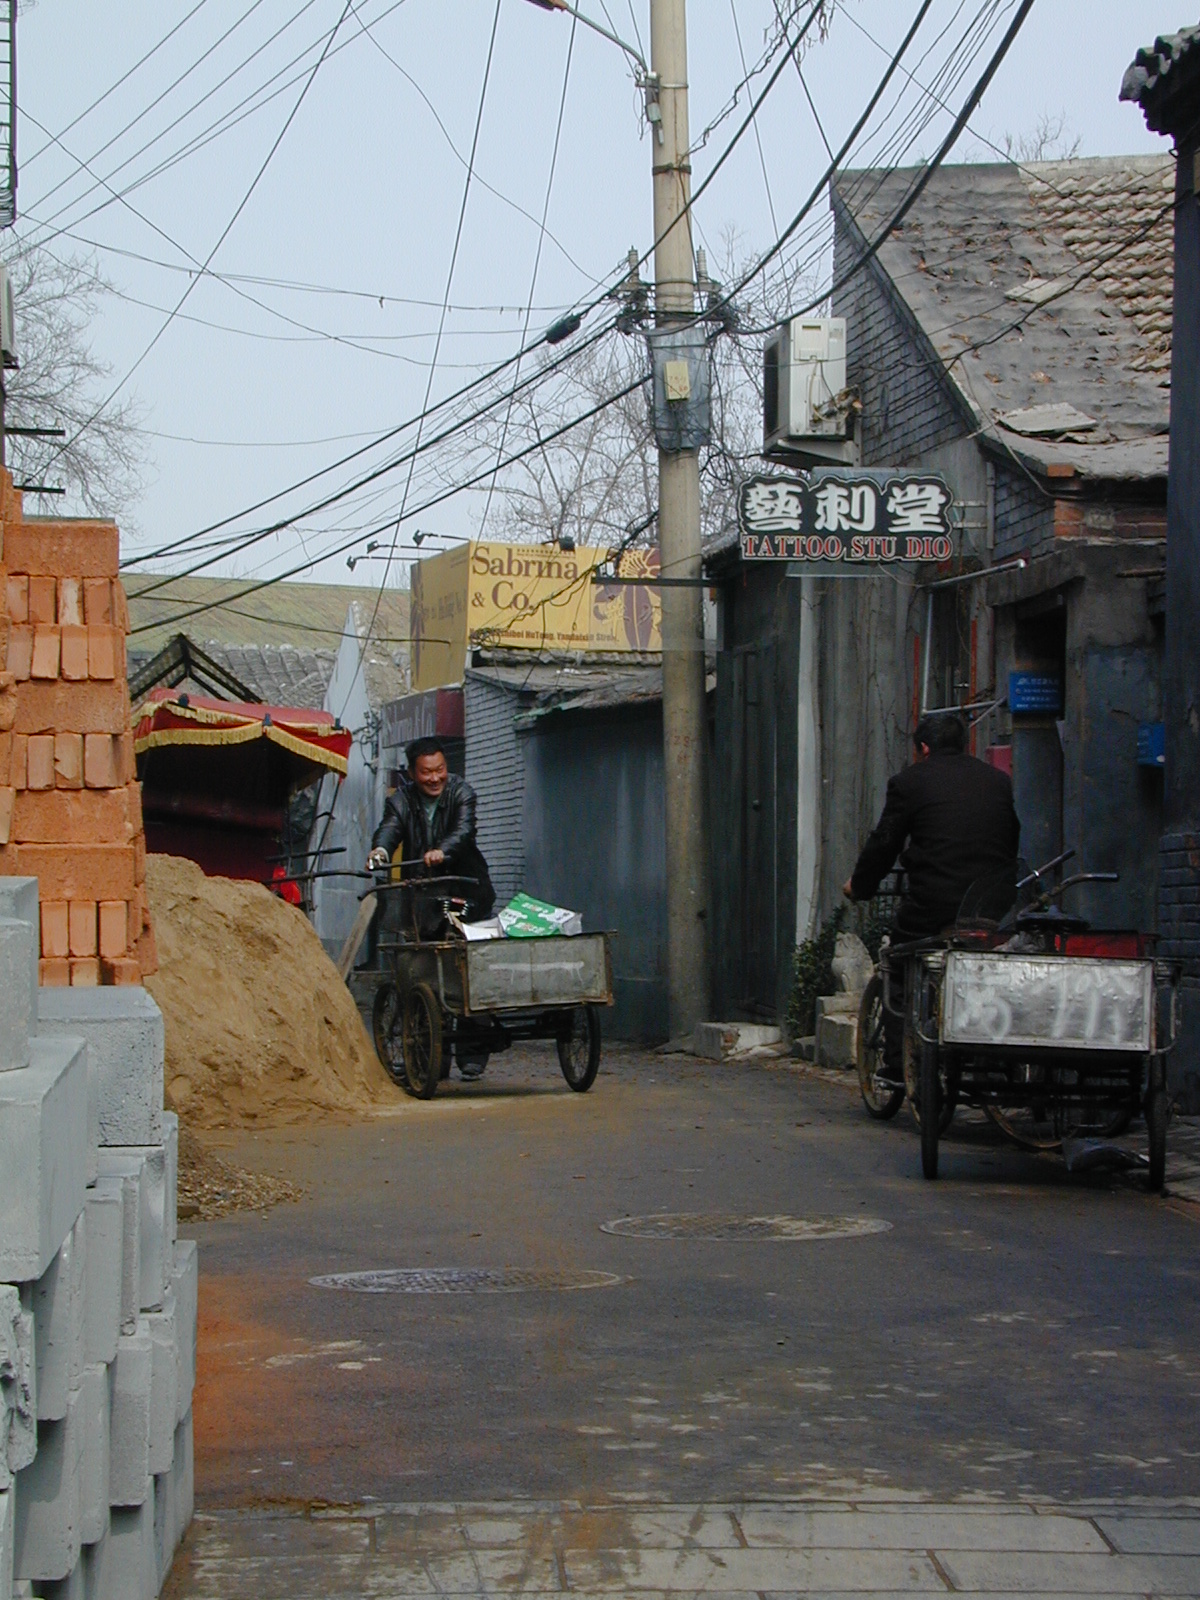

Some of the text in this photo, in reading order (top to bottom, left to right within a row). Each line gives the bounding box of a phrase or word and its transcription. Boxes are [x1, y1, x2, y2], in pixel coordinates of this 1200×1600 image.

[743, 535, 842, 558] TATTOO
[472, 546, 579, 580] Sabrina
[471, 591, 486, 608] &
[491, 580, 535, 611] Co.
